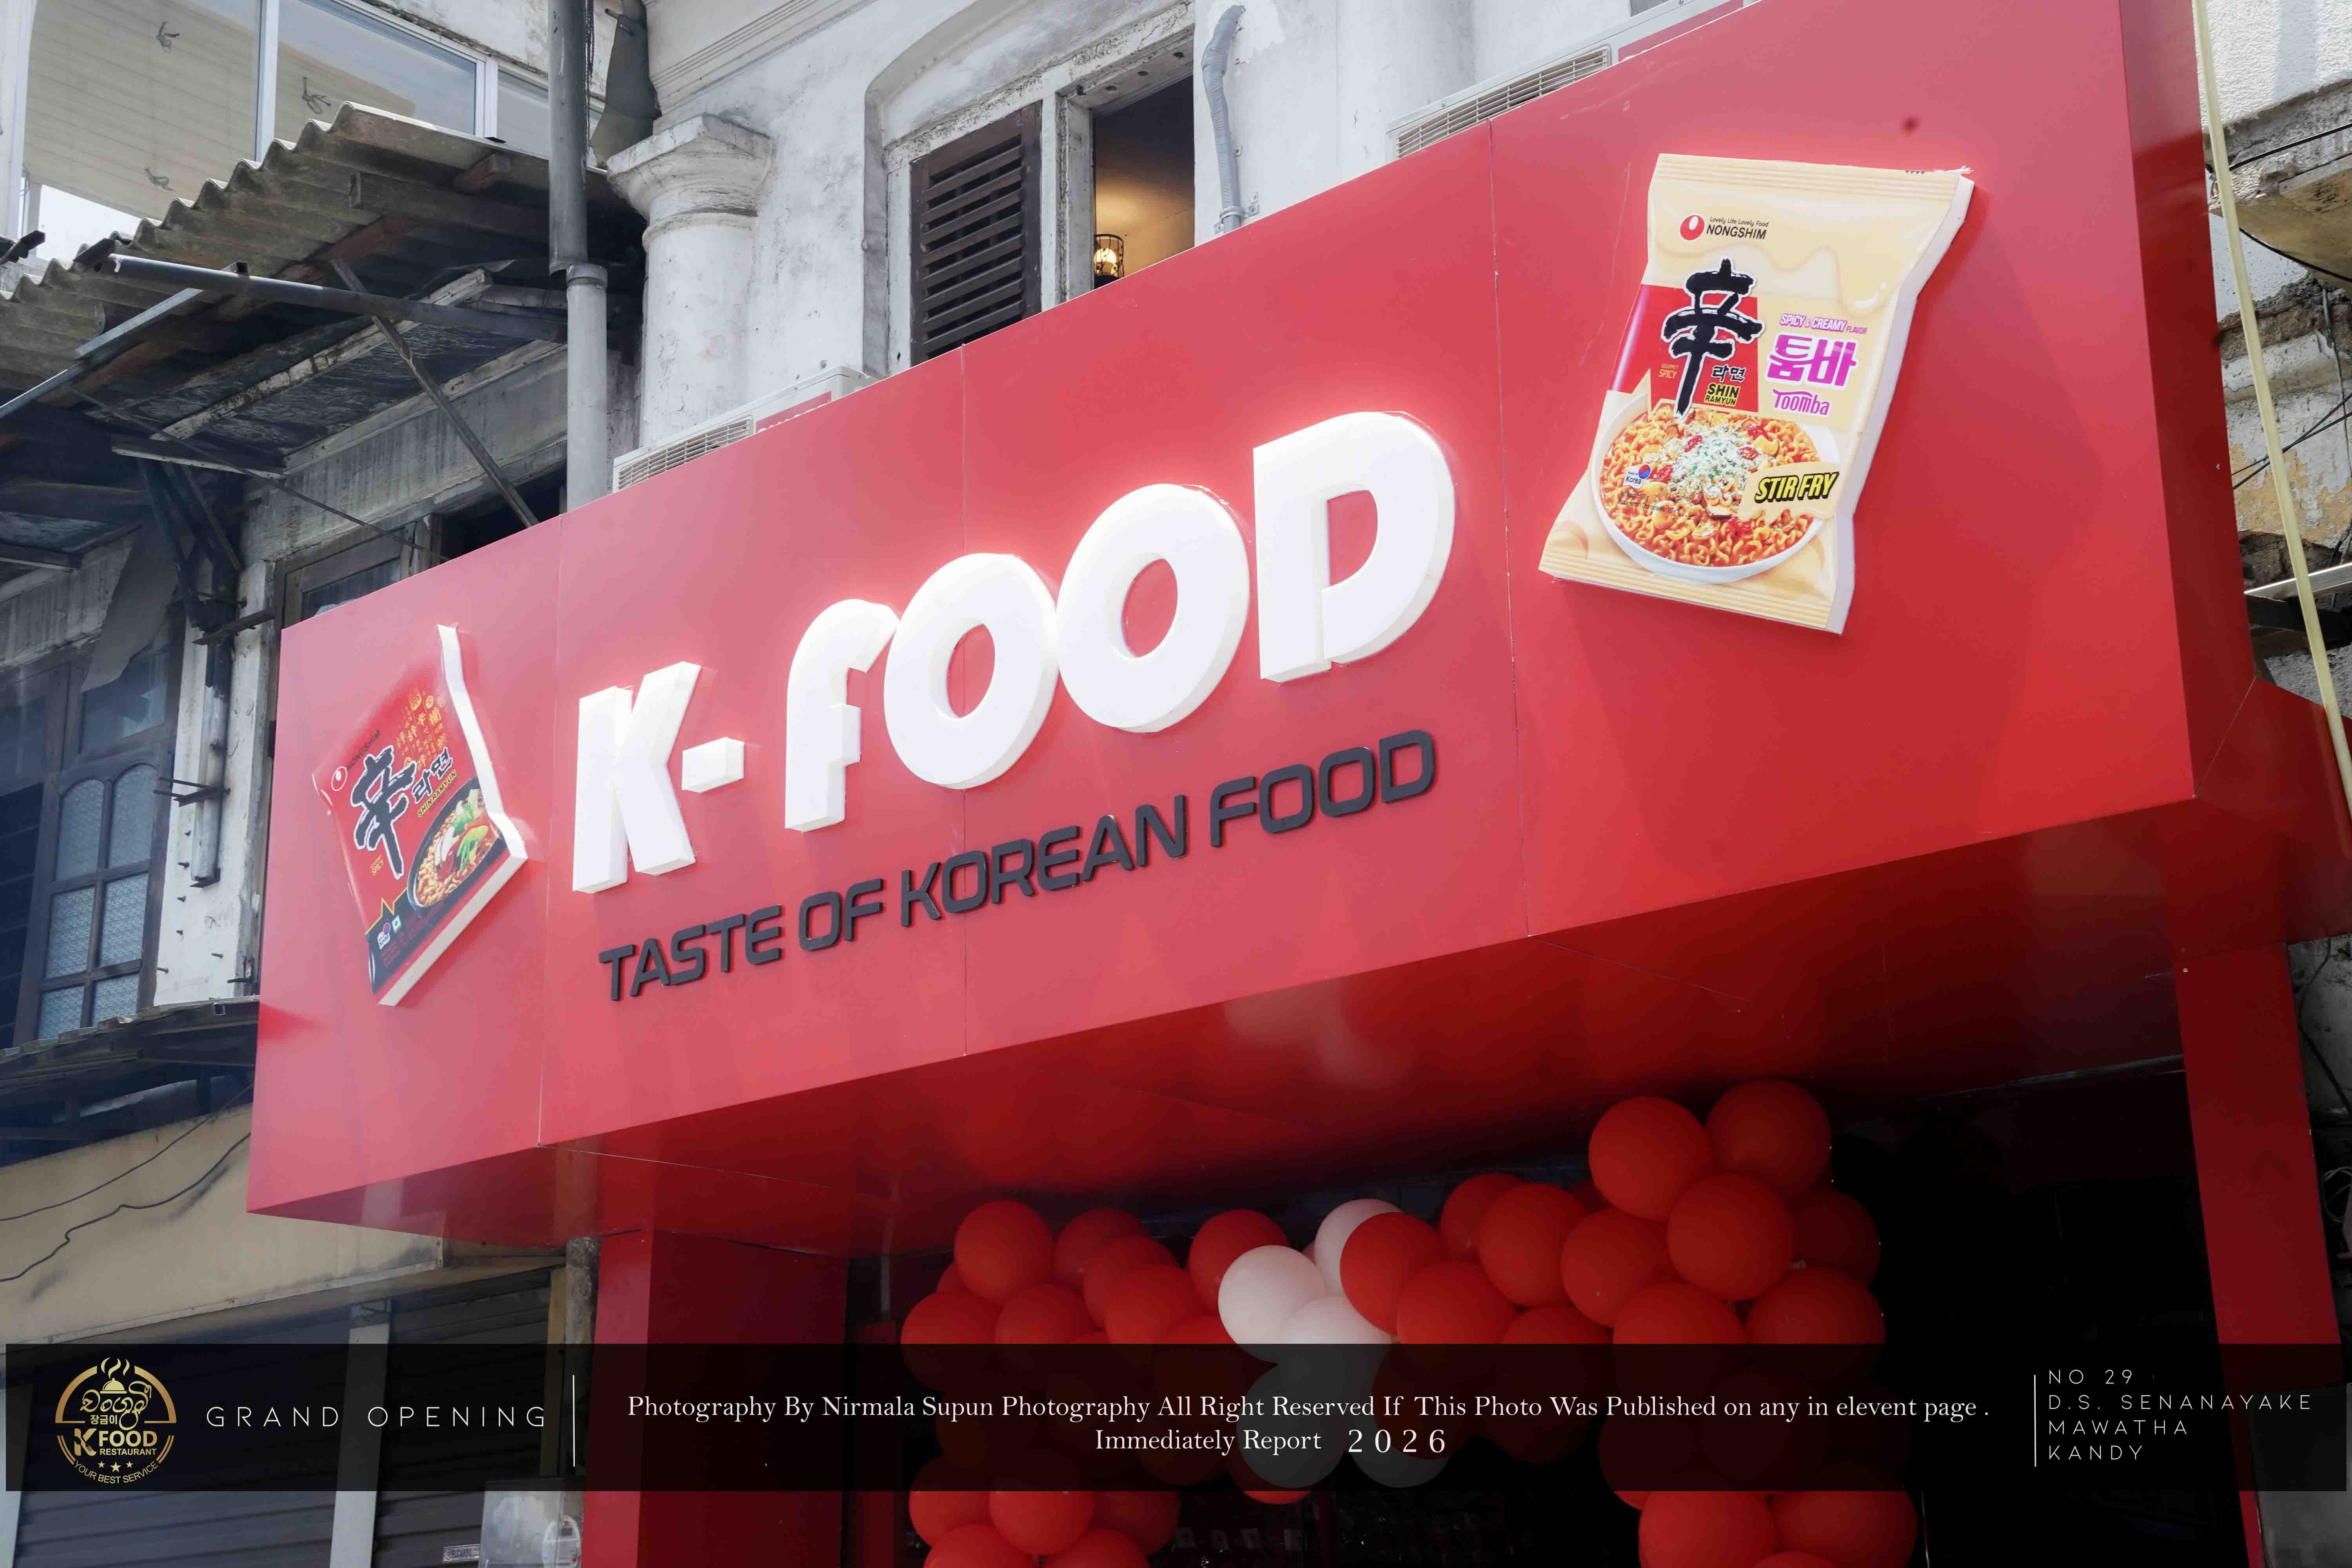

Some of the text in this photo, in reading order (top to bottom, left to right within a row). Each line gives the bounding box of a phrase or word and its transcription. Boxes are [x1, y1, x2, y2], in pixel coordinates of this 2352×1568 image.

[1710, 216, 1726, 225] Lovely
[1707, 224, 1767, 240] NONGSHIM
[1780, 314, 1806, 327] SPICY
[1811, 317, 1847, 332] CREAMY
[1663, 258, 1764, 417] 辛
[1767, 334, 1857, 386] 툼바
[1659, 369, 1678, 379] SPICY
[1711, 365, 1746, 382] 라면
[1705, 395, 1736, 405] RAMYUN
[1708, 383, 1740, 398] SHIN
[1772, 388, 1830, 415] Toomba
[1625, 475, 1642, 484] Korea
[1754, 472, 1840, 503] STIR FRY
[412, 747, 453, 804] 라면
[417, 770, 456, 817] SHIN RAMYUN
[351, 745, 416, 879] 辛
[599, 730, 1436, 1002] TASTE OF KOREAN FOOD
